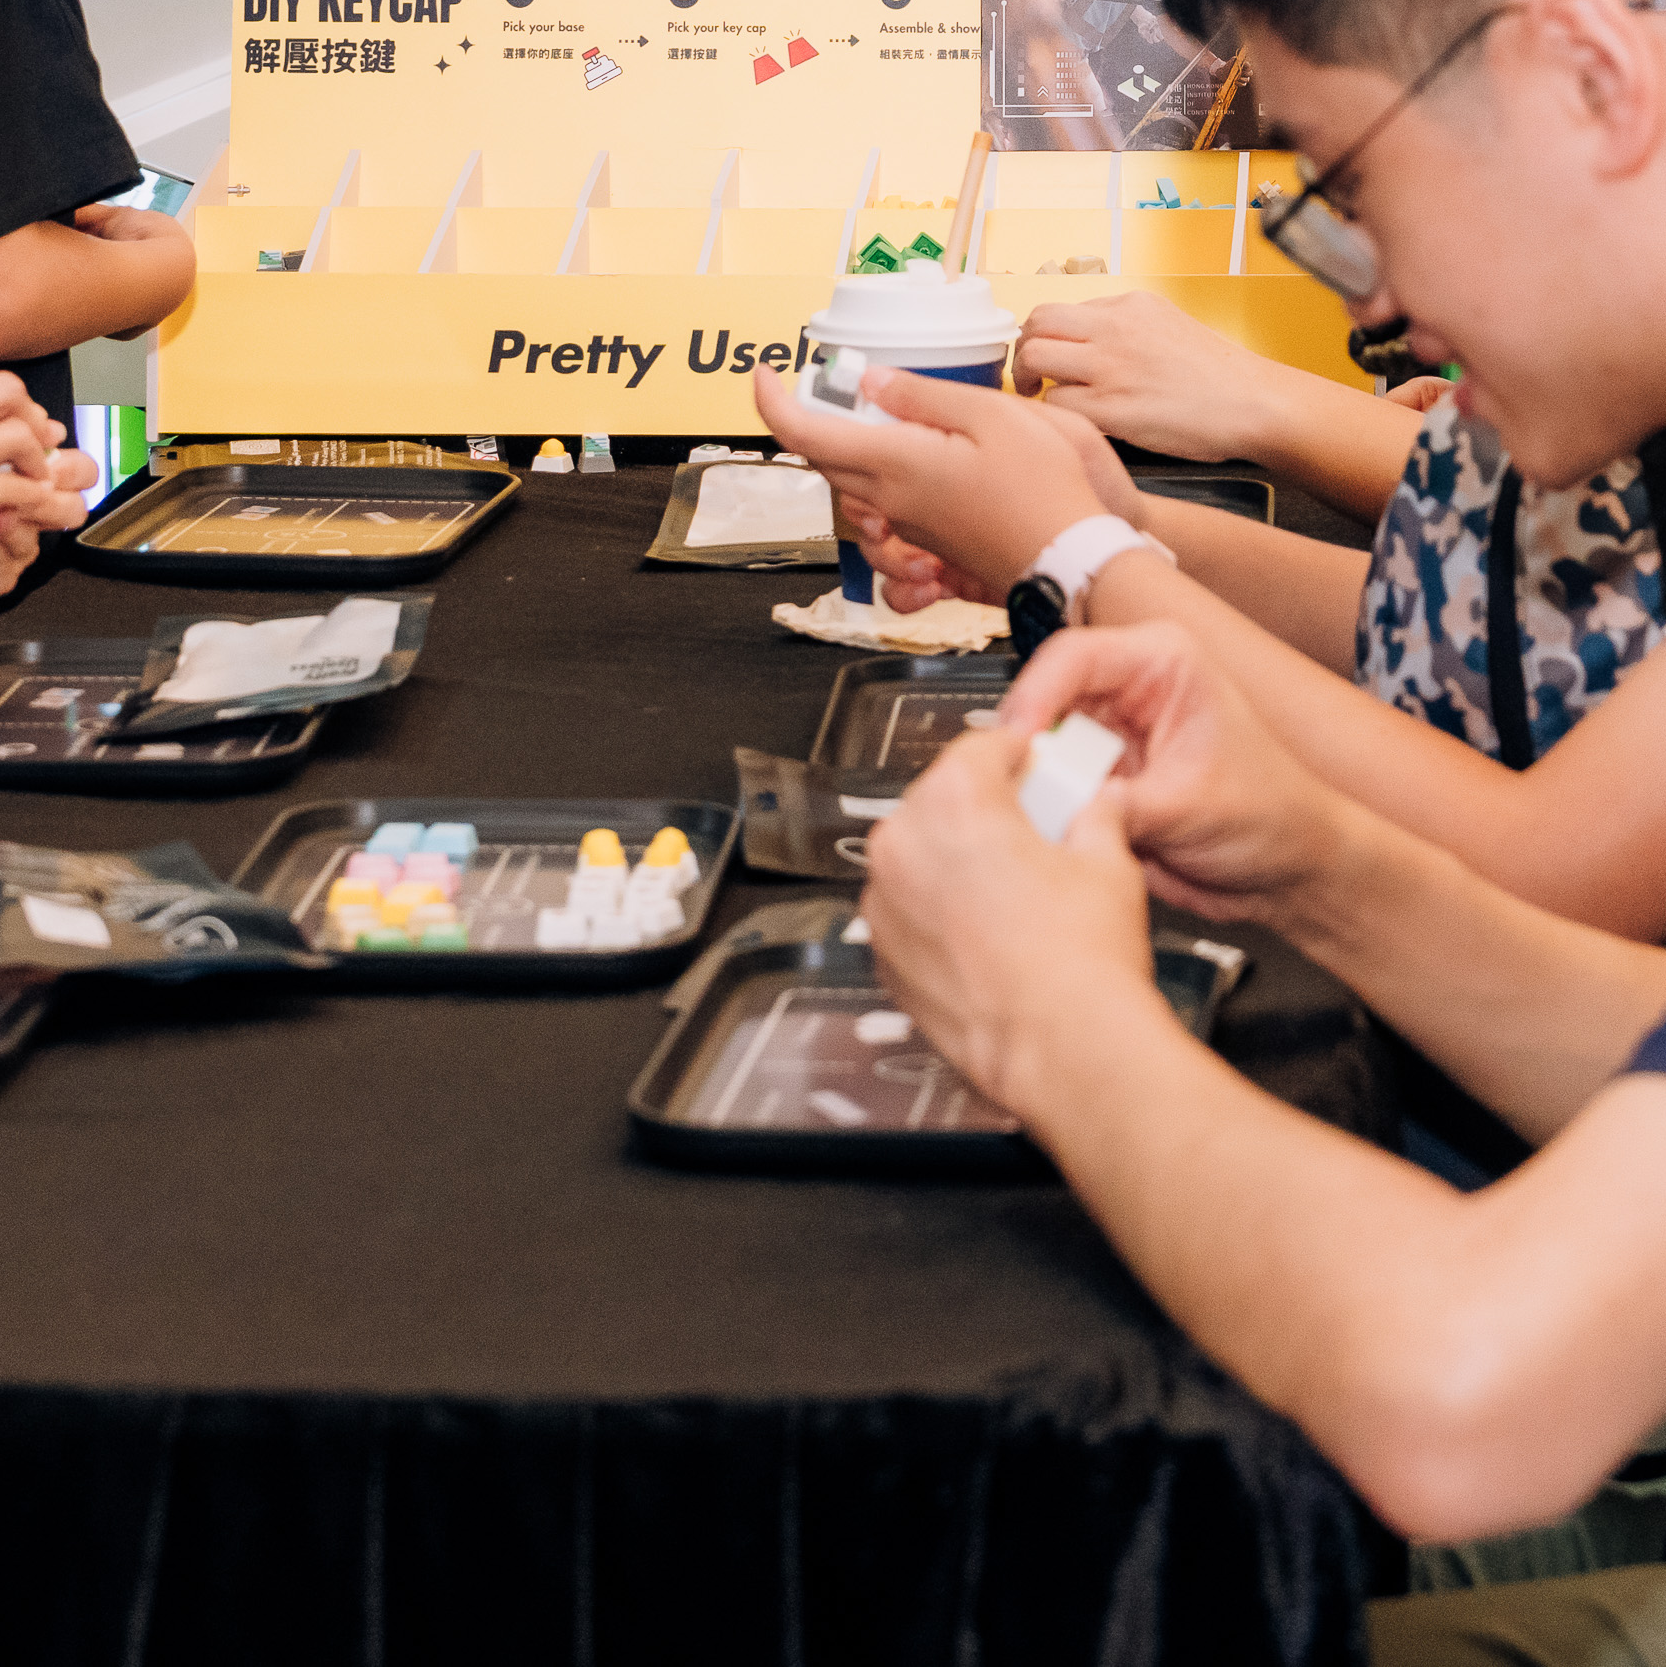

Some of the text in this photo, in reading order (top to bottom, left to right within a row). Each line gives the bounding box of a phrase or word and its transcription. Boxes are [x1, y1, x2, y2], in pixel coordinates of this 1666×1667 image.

[503, 21, 585, 35] Pick your base
[667, 22, 767, 36] Pick your key cap
[879, 22, 981, 34] Assemble & show
[244, 38, 397, 74] 解壓按鍵
[503, 48, 574, 60] 選擇你的底座
[667, 48, 718, 60] 選擇按鍵
[488, 326, 826, 388] Pretty Usel
